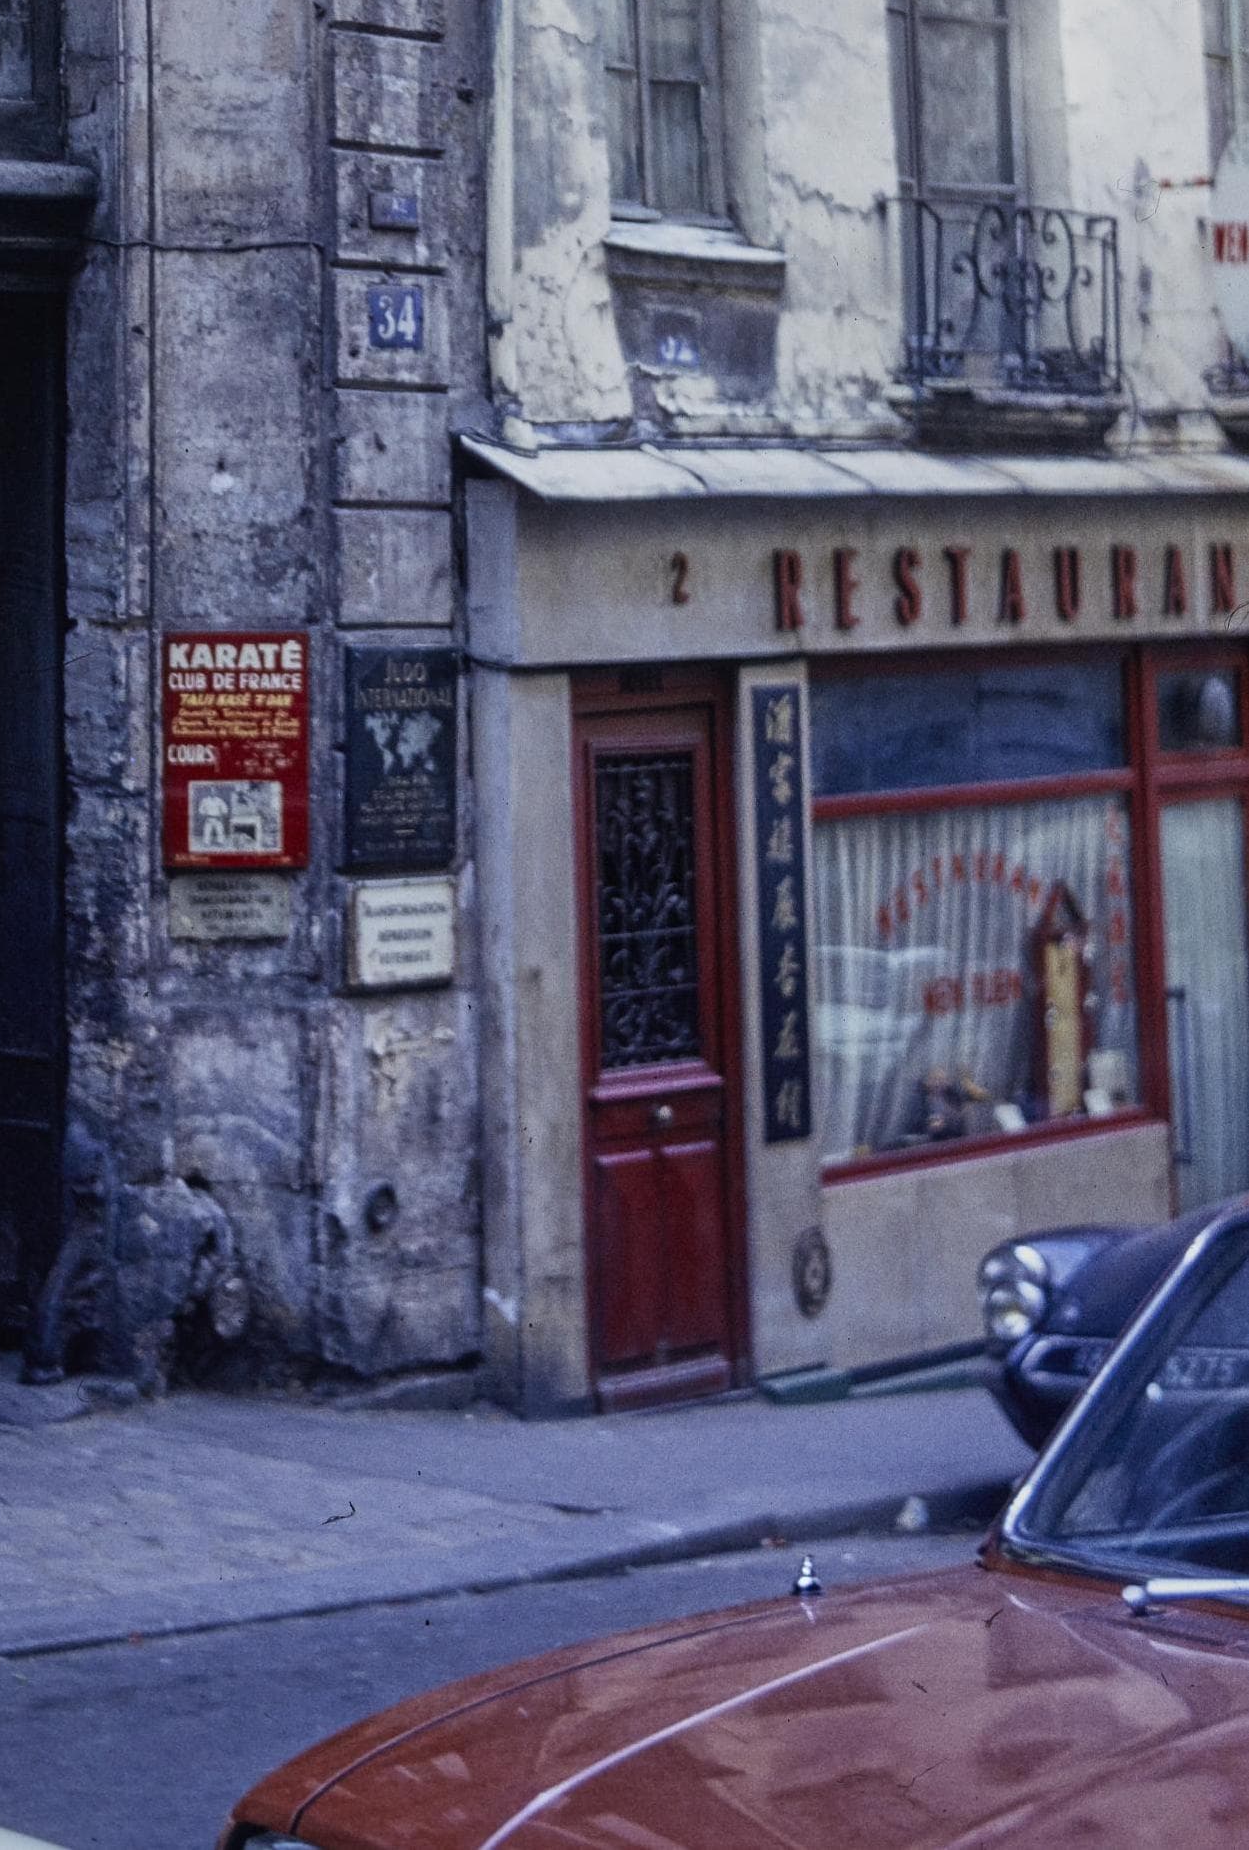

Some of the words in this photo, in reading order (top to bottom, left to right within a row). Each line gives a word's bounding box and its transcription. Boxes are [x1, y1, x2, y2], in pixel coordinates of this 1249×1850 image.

[377, 293, 417, 342] 34
[168, 639, 303, 671] KARATÉ
[168, 672, 207, 691] CLUB
[212, 672, 236, 691] DE
[239, 672, 302, 692] FRANCE
[384, 657, 427, 685] JUDO
[353, 683, 453, 711] INTERNATIONAL
[167, 743, 217, 765] COURS
[875, 851, 1044, 940] RESTAURAN
